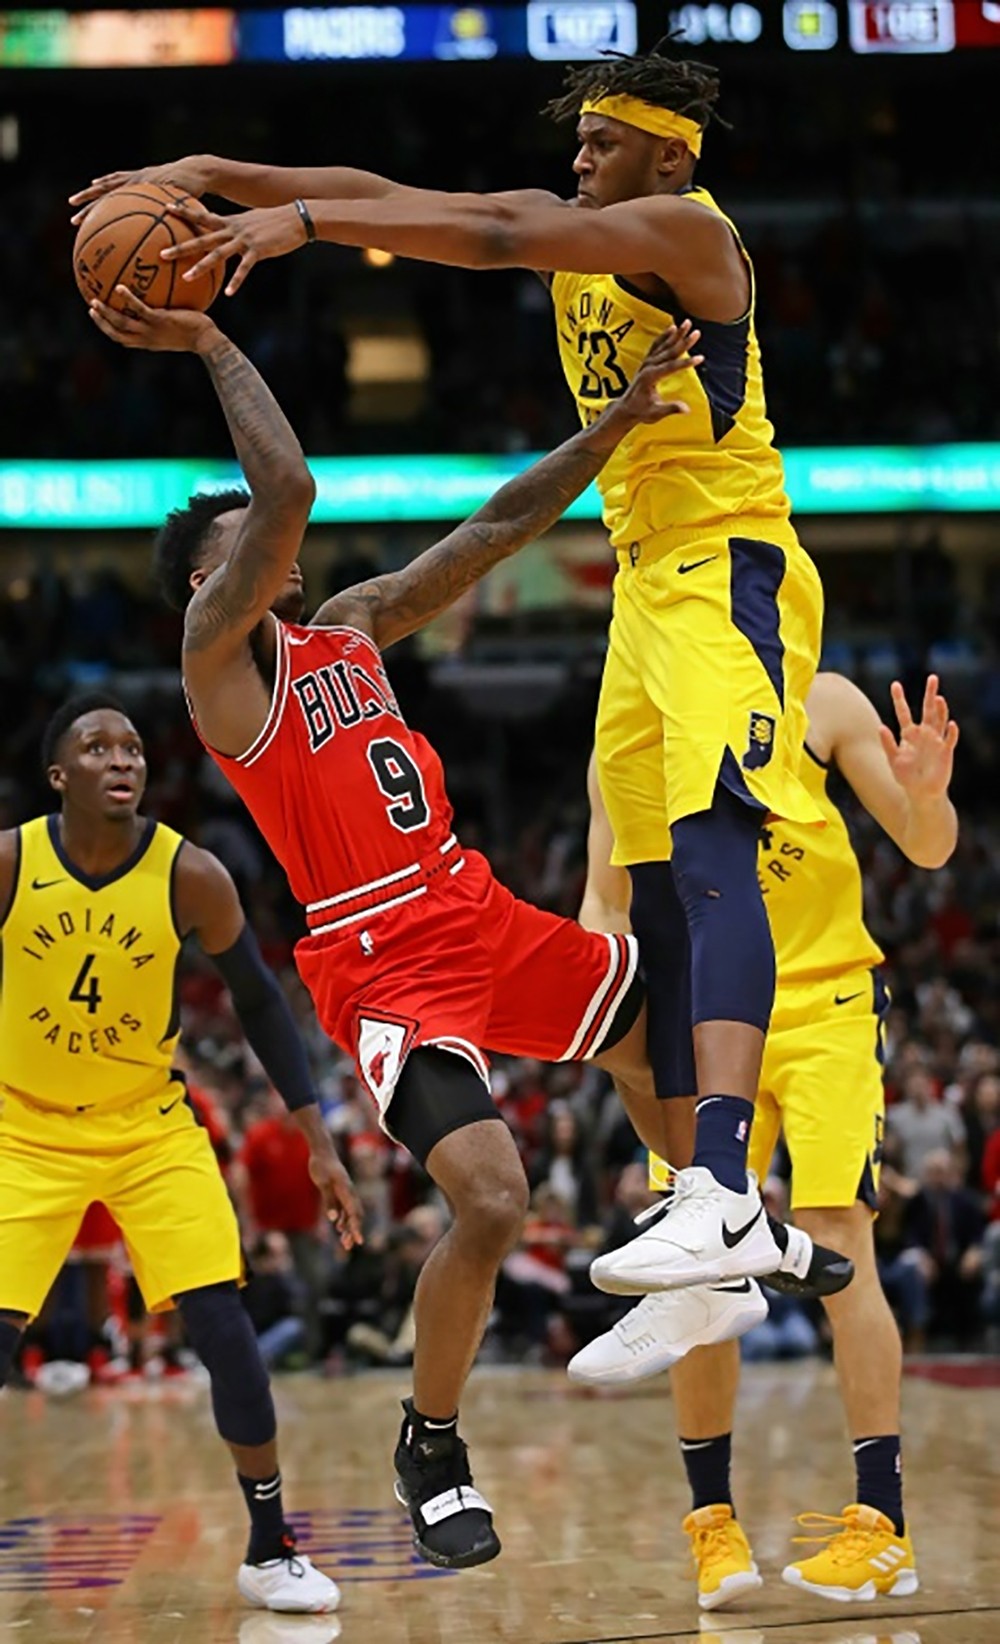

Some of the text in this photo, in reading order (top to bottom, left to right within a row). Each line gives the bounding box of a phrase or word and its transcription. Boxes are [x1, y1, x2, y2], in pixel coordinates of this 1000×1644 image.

[578, 330, 630, 398] 33
[366, 737, 431, 834] 9
[22, 908, 155, 969] INDIANA
[68, 954, 102, 1014] 4
[29, 1006, 142, 1054] PACERS
